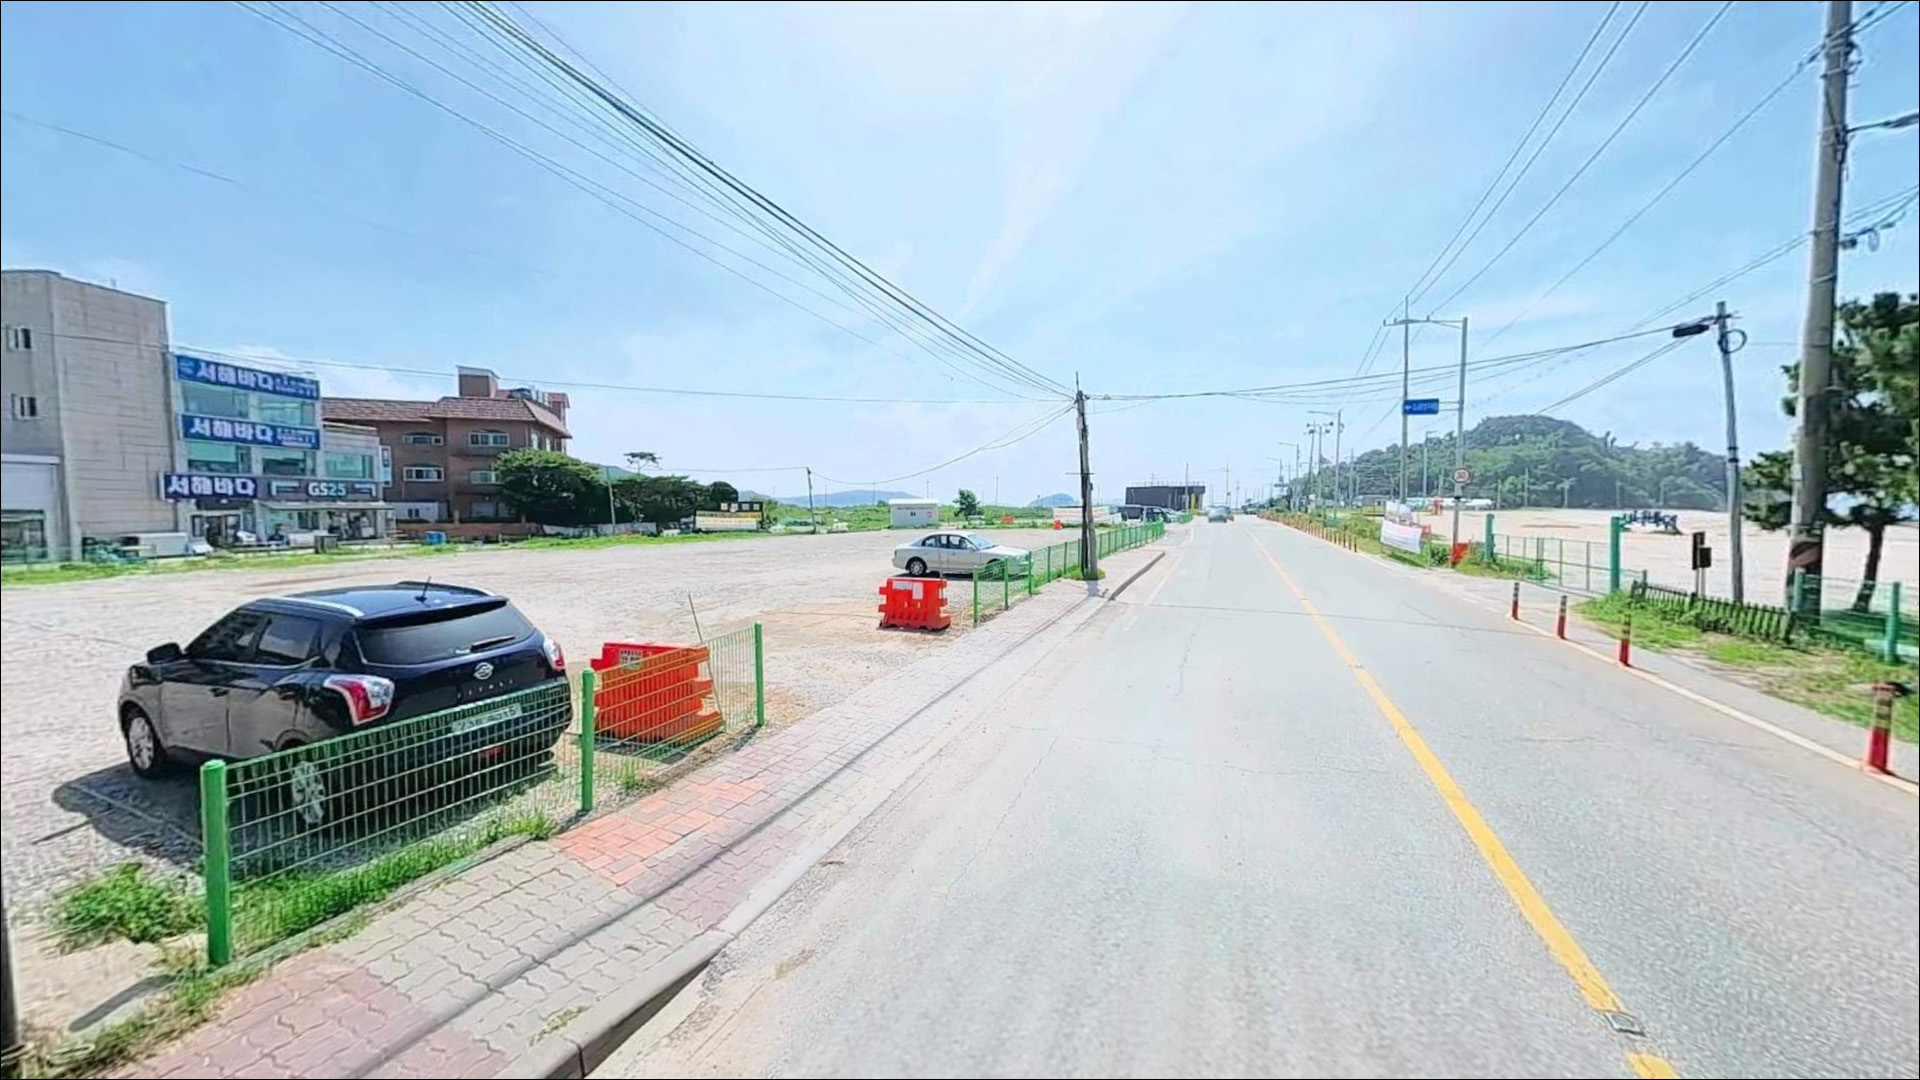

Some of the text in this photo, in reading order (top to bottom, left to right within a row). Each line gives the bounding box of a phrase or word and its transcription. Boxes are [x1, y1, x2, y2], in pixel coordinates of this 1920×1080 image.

[198, 361, 274, 389] 서해바다
[190, 418, 273, 442] 서해바다
[167, 475, 255, 497] 서해바다
[308, 482, 347, 497] GS25
